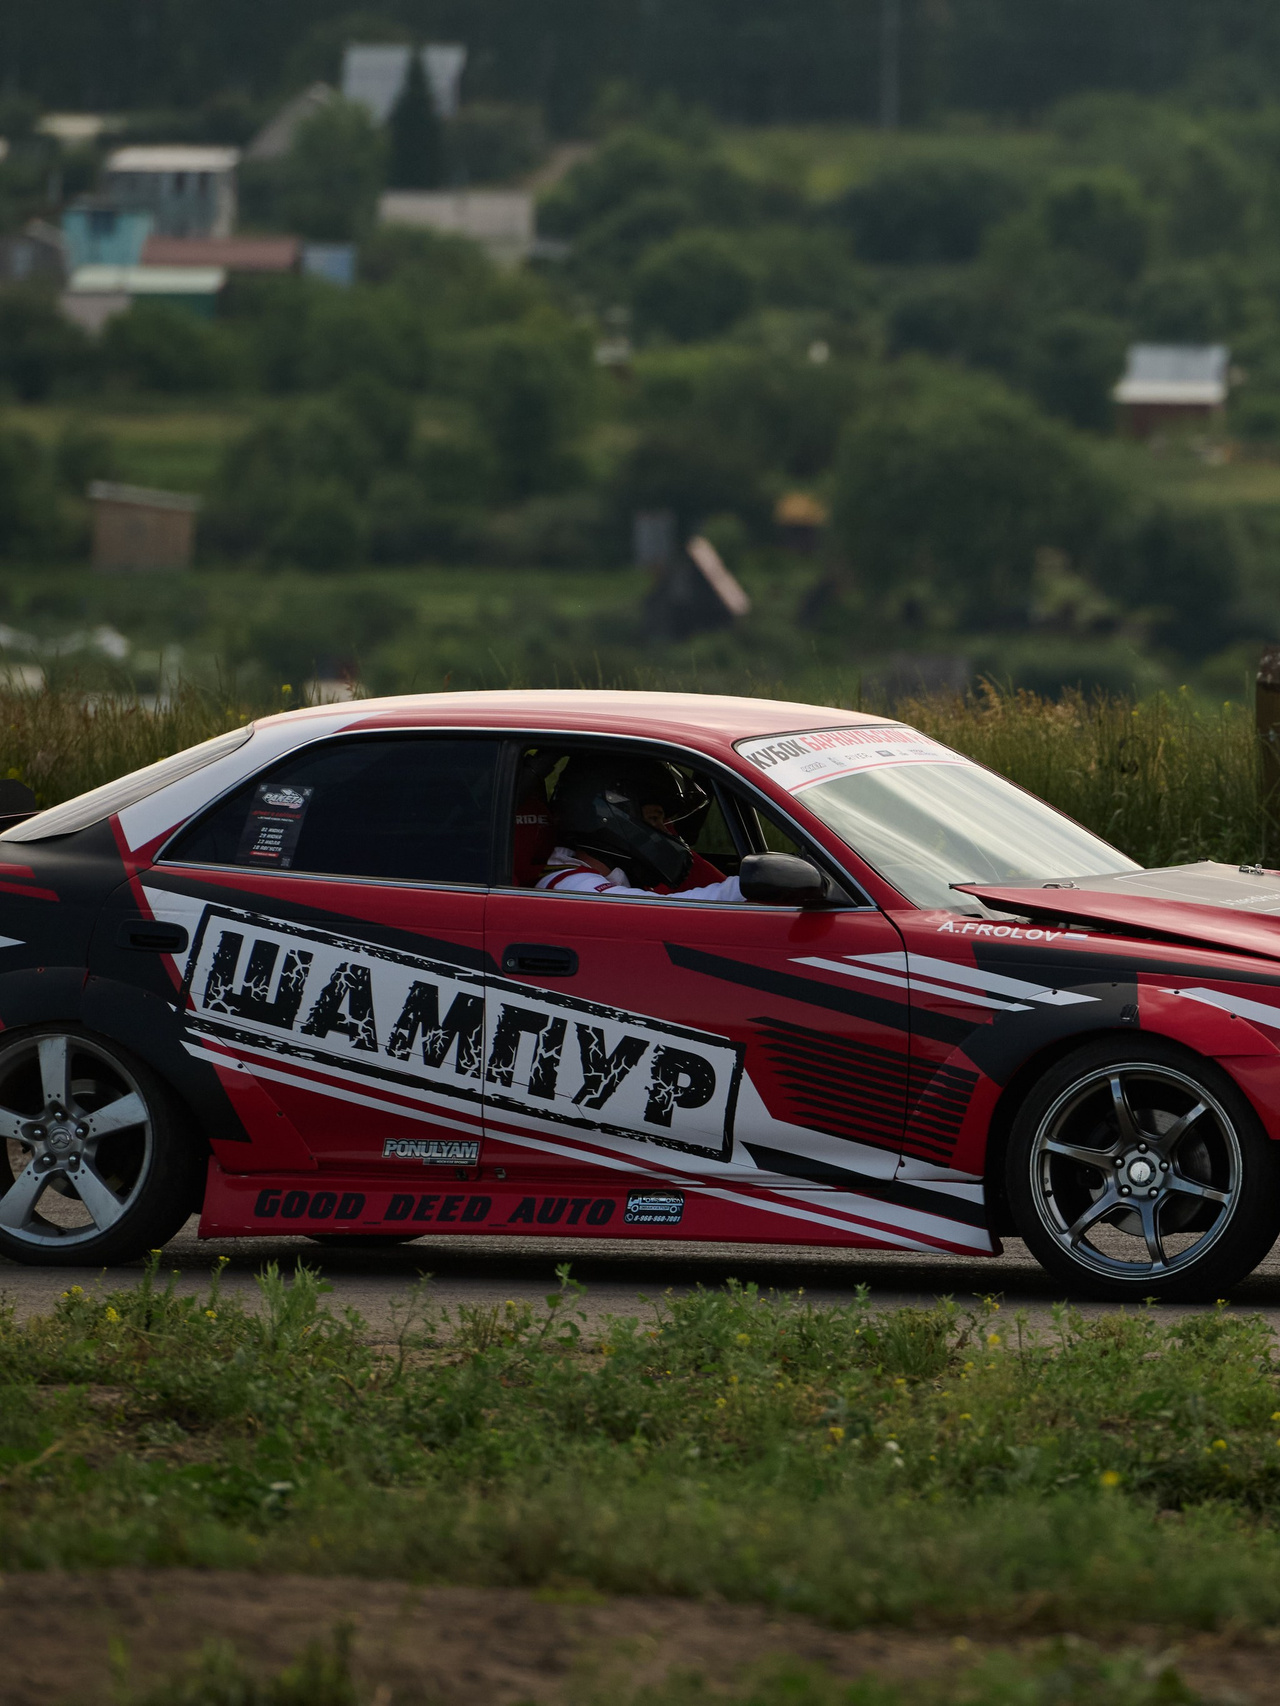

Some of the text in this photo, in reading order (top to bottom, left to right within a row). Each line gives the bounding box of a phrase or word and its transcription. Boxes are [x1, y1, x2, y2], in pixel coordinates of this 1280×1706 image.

[746, 738, 811, 770] КУБОК
[937, 920, 1062, 942] A.FROLOV
[202, 930, 717, 1128] ШАМПУР
[384, 1140, 478, 1158] PONULYAM
